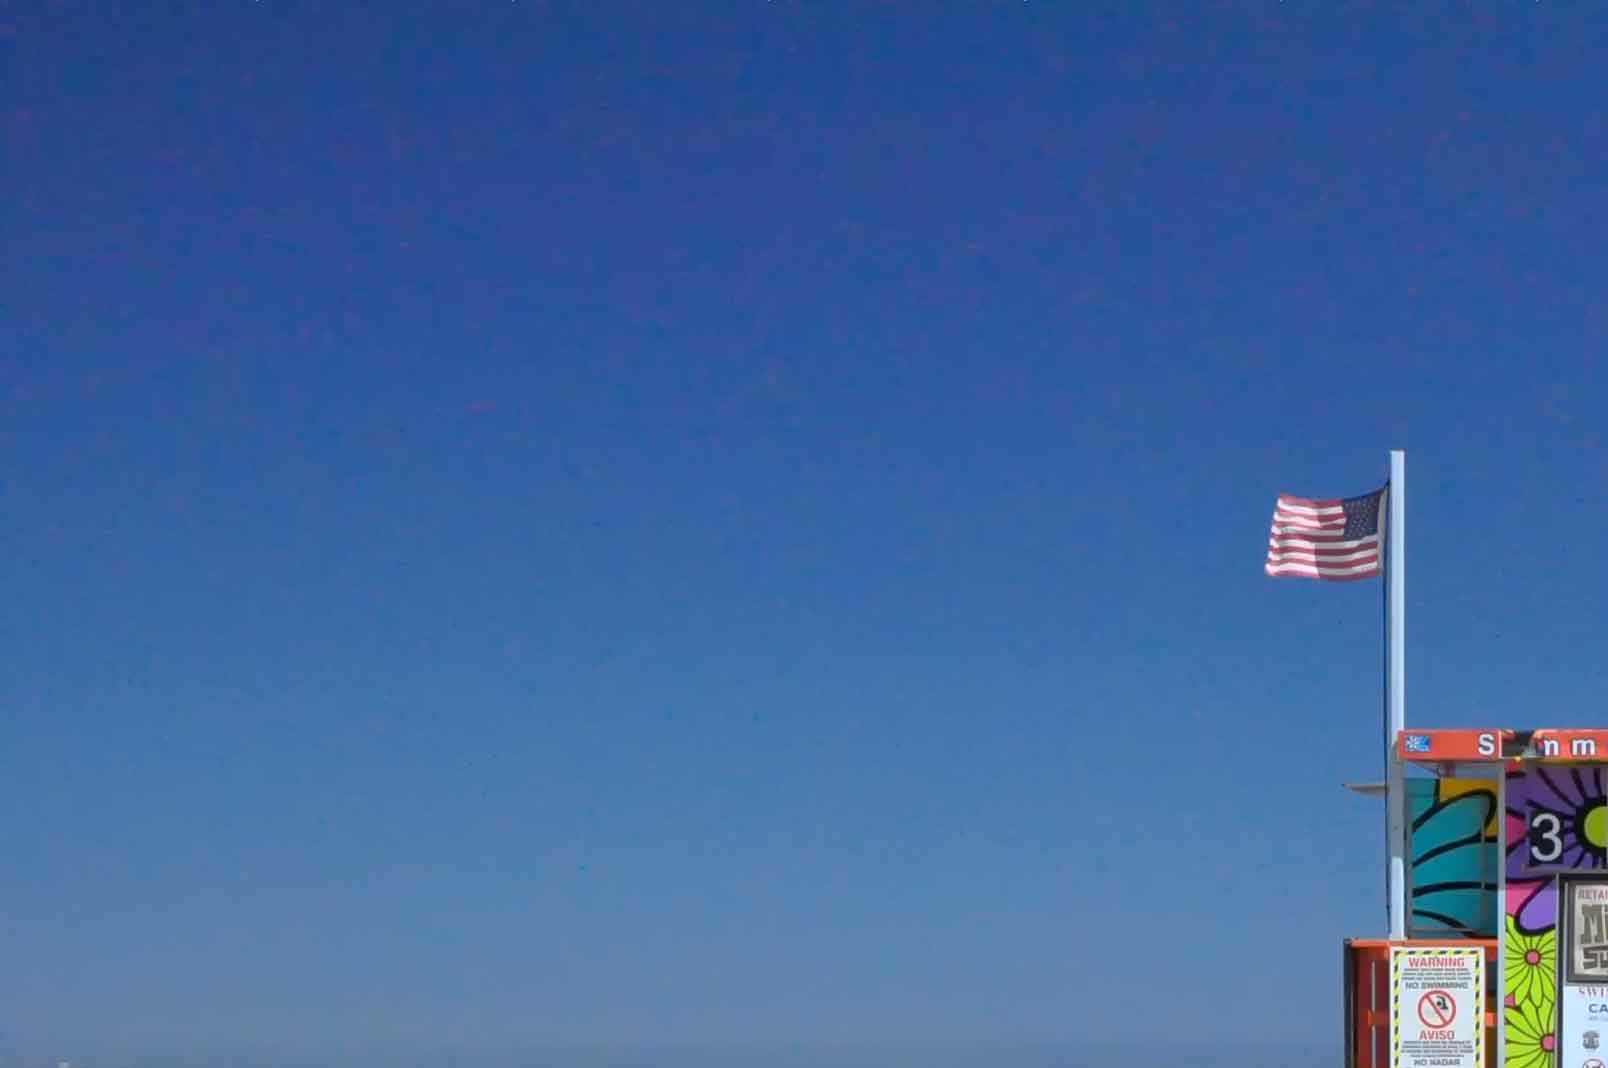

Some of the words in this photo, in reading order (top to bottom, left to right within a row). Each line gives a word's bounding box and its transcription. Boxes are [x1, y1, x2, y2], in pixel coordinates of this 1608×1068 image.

[1531, 812, 1563, 862] 3
[1408, 957, 1465, 967] WARNING
[1419, 1030, 1455, 1040] AVISO
